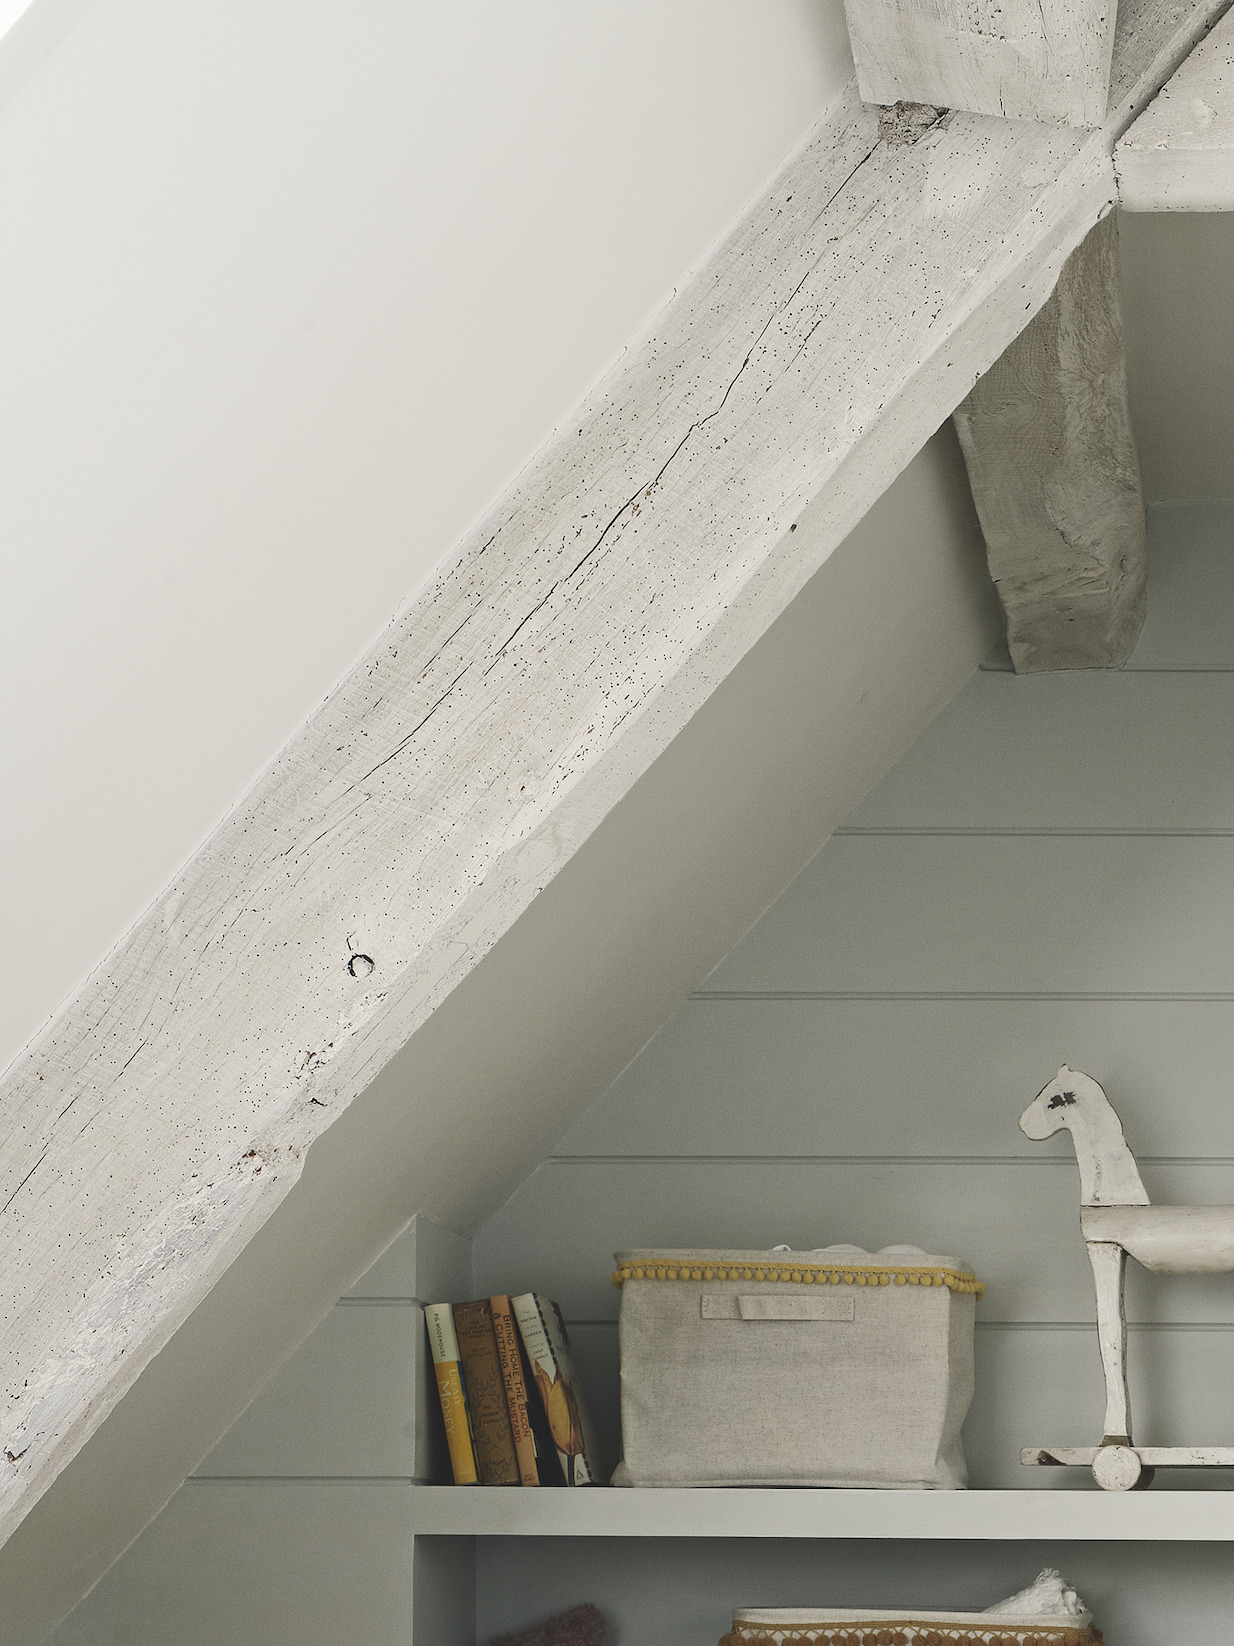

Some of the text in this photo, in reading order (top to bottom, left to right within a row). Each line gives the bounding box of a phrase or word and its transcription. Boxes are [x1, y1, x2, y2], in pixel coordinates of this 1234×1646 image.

[439, 1380, 455, 1435] MONEY
[493, 1312, 521, 1443] & CUTTING THE MUSTARD
[503, 1314, 530, 1438] BRING HOME THE BACON
